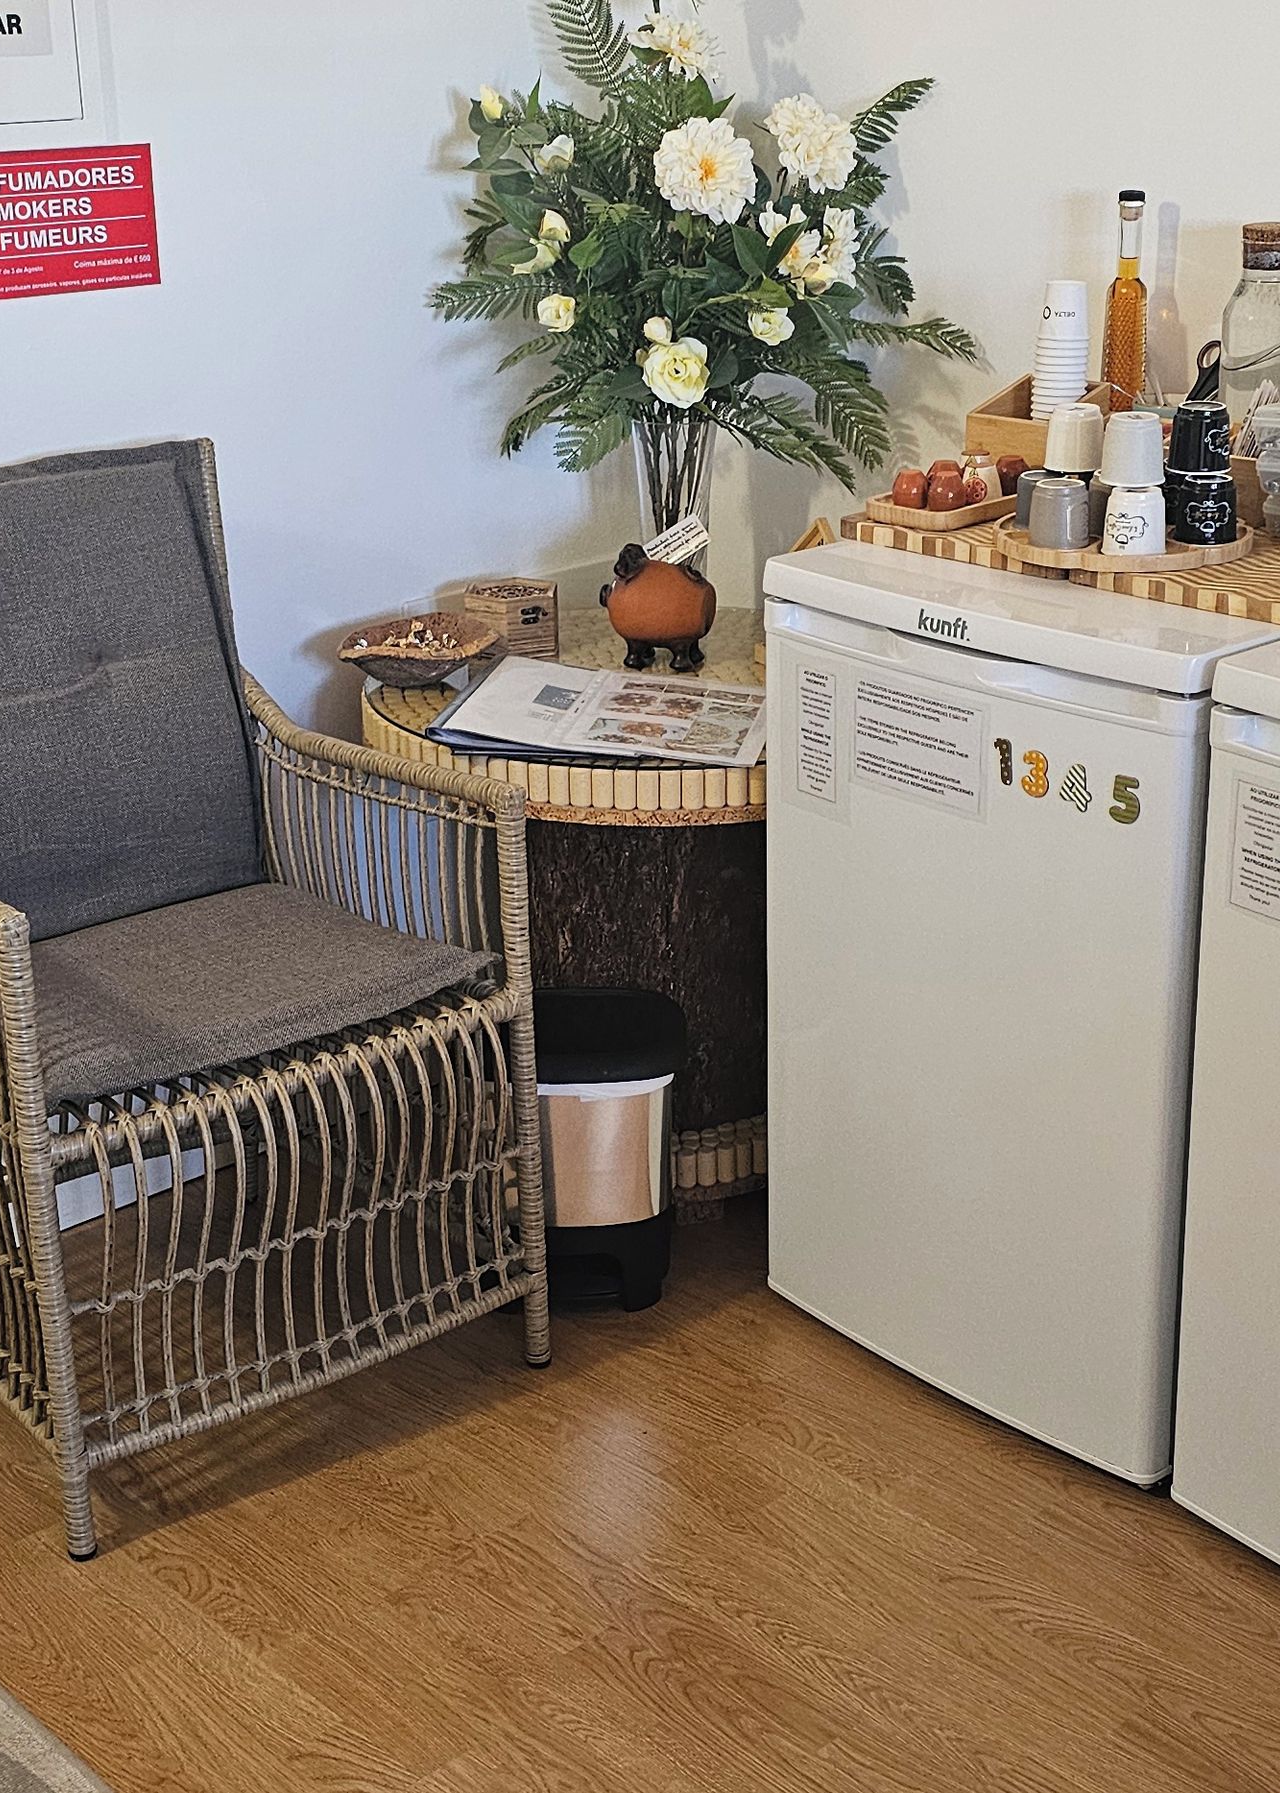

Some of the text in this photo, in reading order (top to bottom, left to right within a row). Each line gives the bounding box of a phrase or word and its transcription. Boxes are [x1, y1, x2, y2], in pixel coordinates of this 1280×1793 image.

[0, 224, 108, 251] FUMEURS
[73, 260, 95, 268] Coima
[994, 738, 1140, 825] 1 3 4 5
